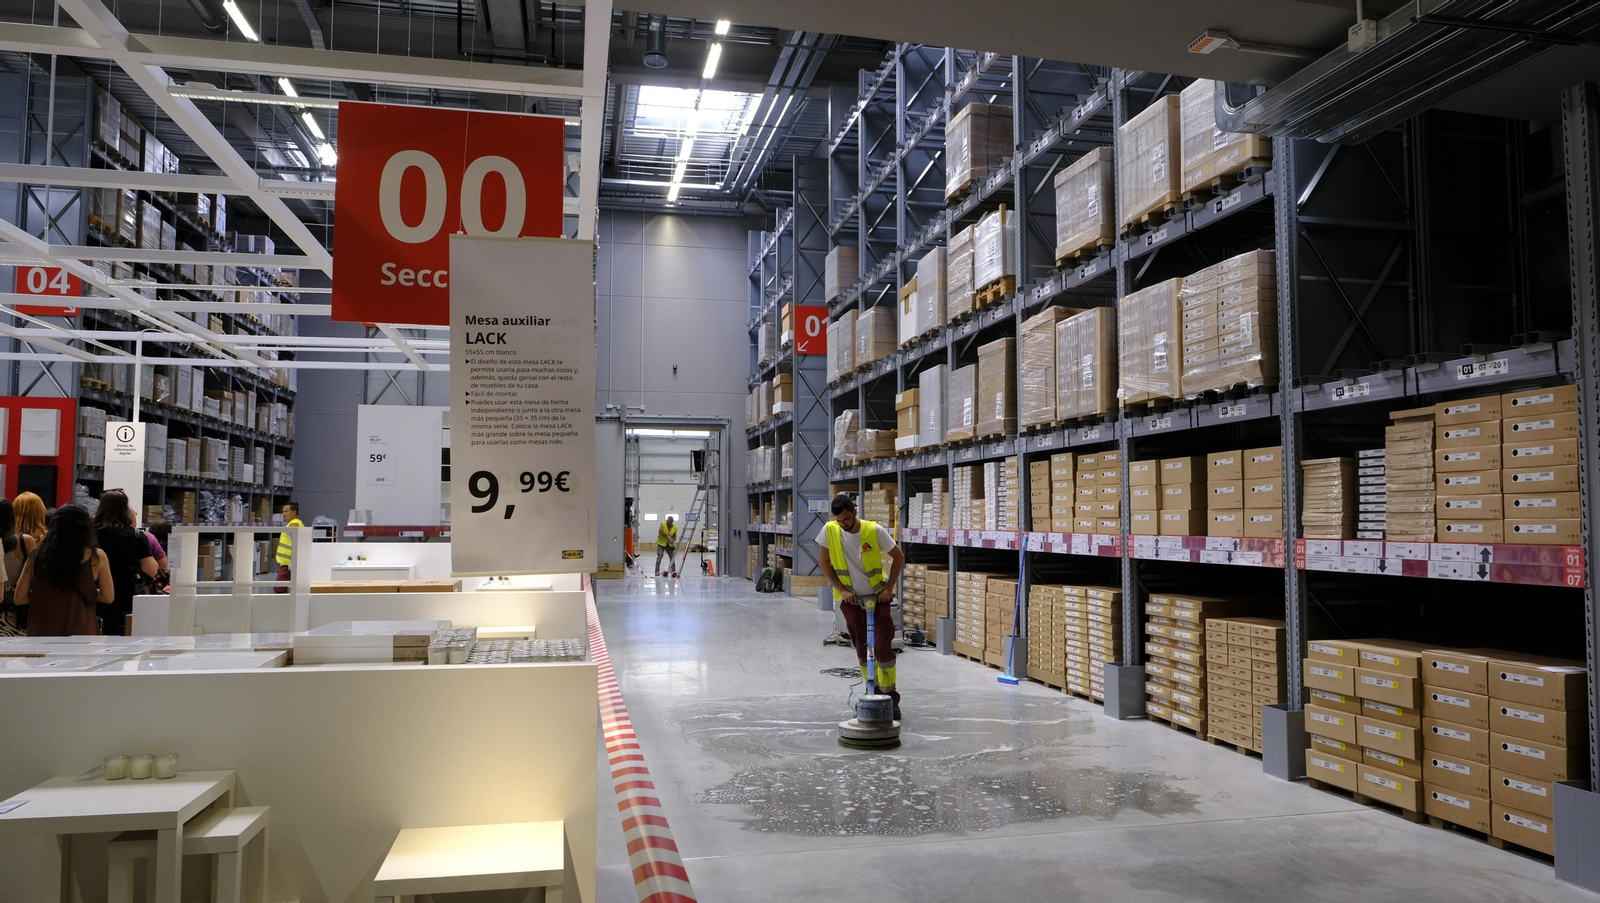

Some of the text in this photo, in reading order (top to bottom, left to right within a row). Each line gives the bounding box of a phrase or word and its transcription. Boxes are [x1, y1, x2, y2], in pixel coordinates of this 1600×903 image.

[379, 150, 527, 244] 00
[27, 267, 71, 294] 04
[380, 262, 449, 288] Secc
[465, 315, 551, 326] Mesa auxiliar
[466, 332, 507, 345] LACK
[1463, 366, 1472, 374] 01
[1337, 388, 1343, 396] 01
[370, 454, 387, 463] 59€
[468, 470, 570, 519] 9,99€
[1296, 546, 1304, 554] 01
[1296, 560, 1304, 568] 08
[1567, 554, 1580, 566] 01
[1567, 575, 1581, 586] 07
